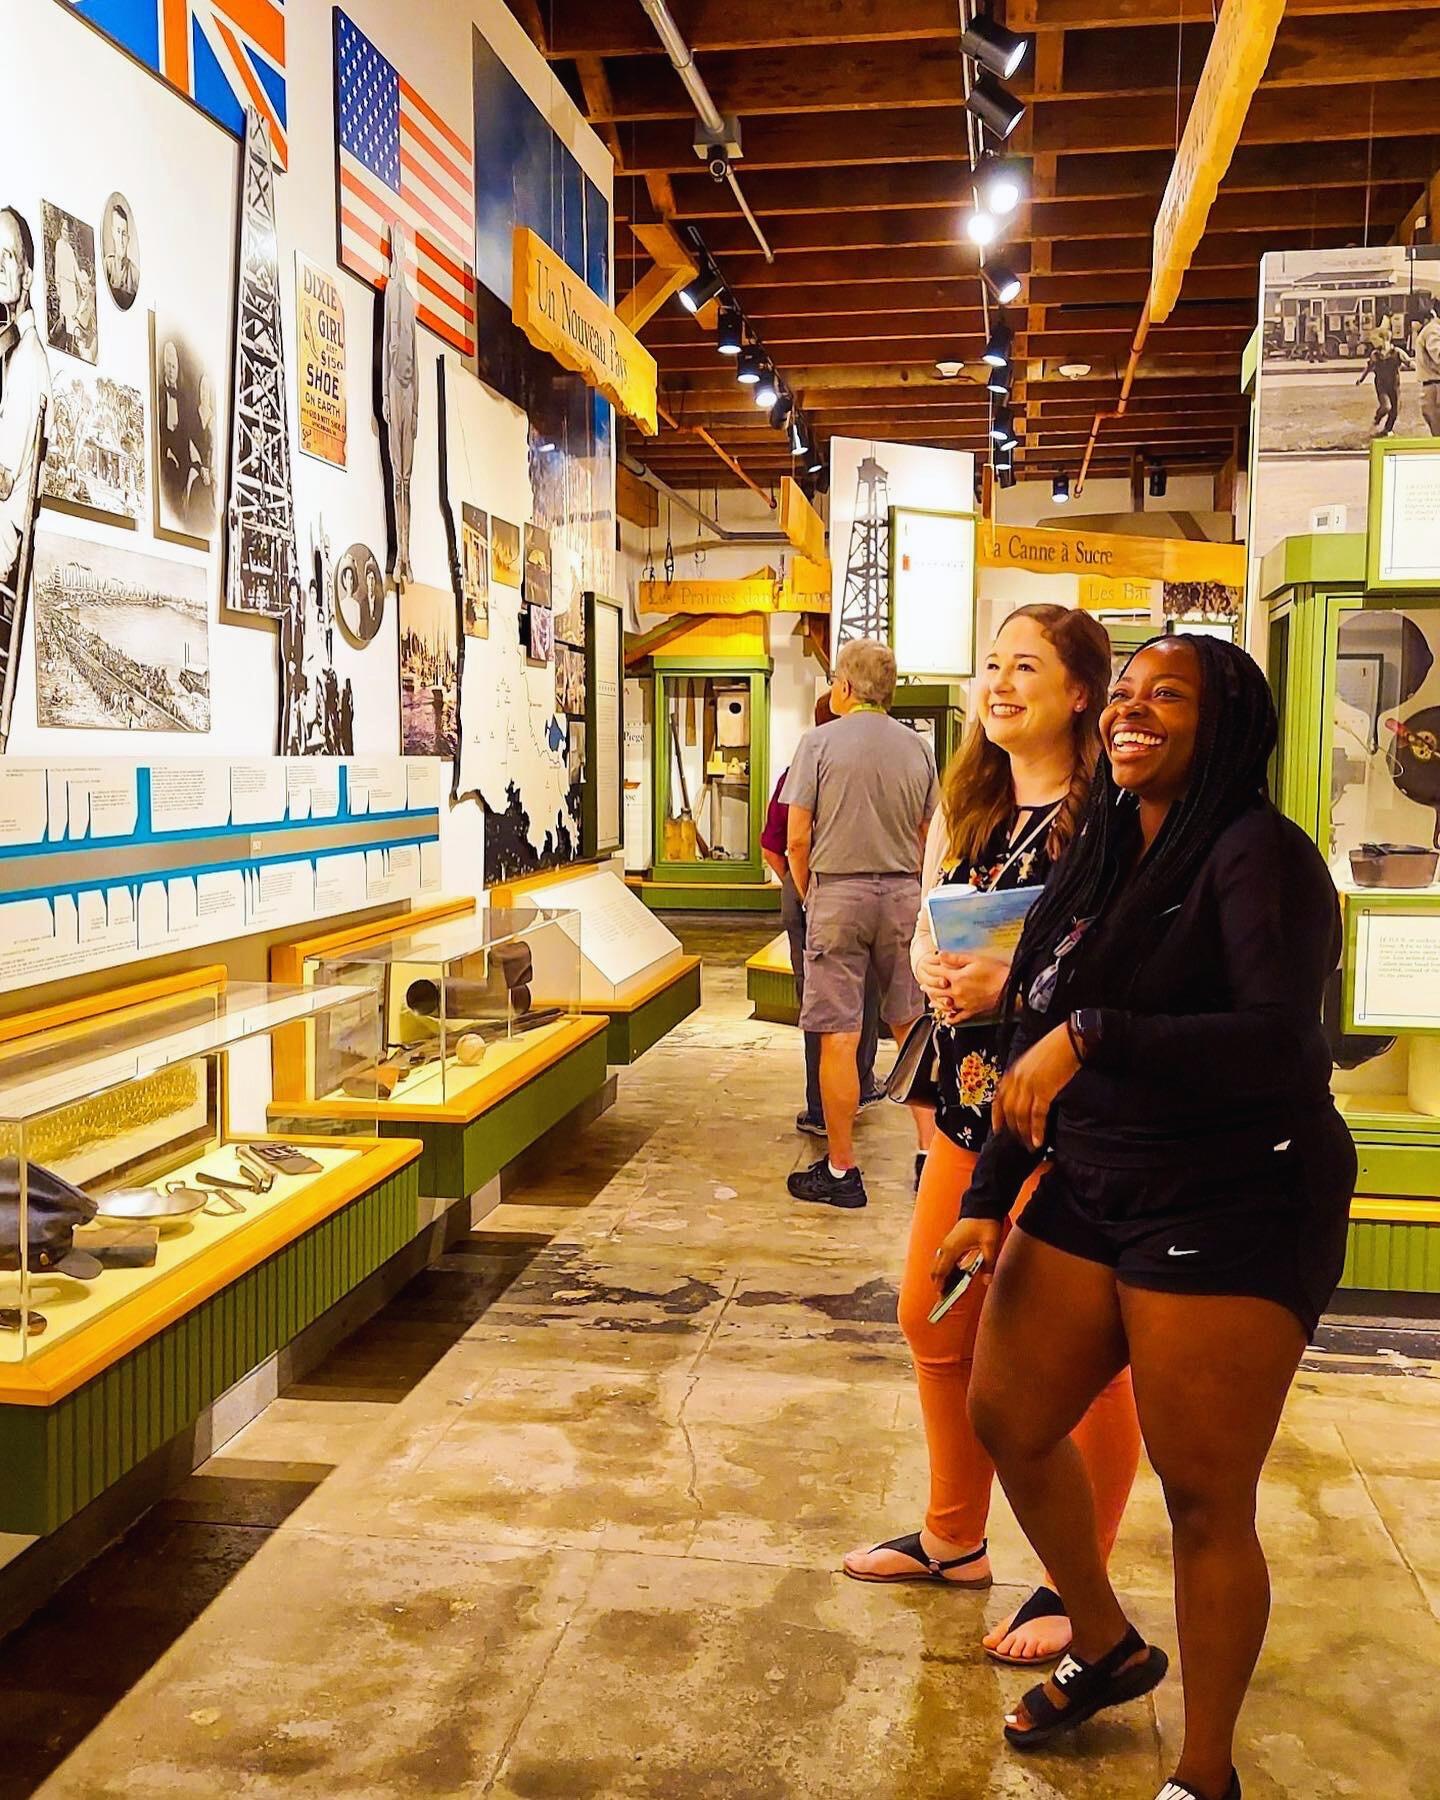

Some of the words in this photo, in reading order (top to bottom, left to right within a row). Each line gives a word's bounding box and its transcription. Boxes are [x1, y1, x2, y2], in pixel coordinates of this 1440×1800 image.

[303, 264, 337, 312] DIXIE
[318, 309, 344, 349] GIRL
[536, 259, 556, 322] Un
[561, 281, 606, 364] Nouveau
[609, 328, 628, 389] Pays
[306, 362, 340, 401] SHOE
[305, 391, 316, 406] ON
[318, 397, 341, 419] EARTH
[1008, 534, 1056, 561] Canne
[1061, 541, 1069, 563] à
[1075, 540, 1113, 565] Sucre
[681, 586, 736, 605] Prairies
[1088, 583, 1114, 601] Les
